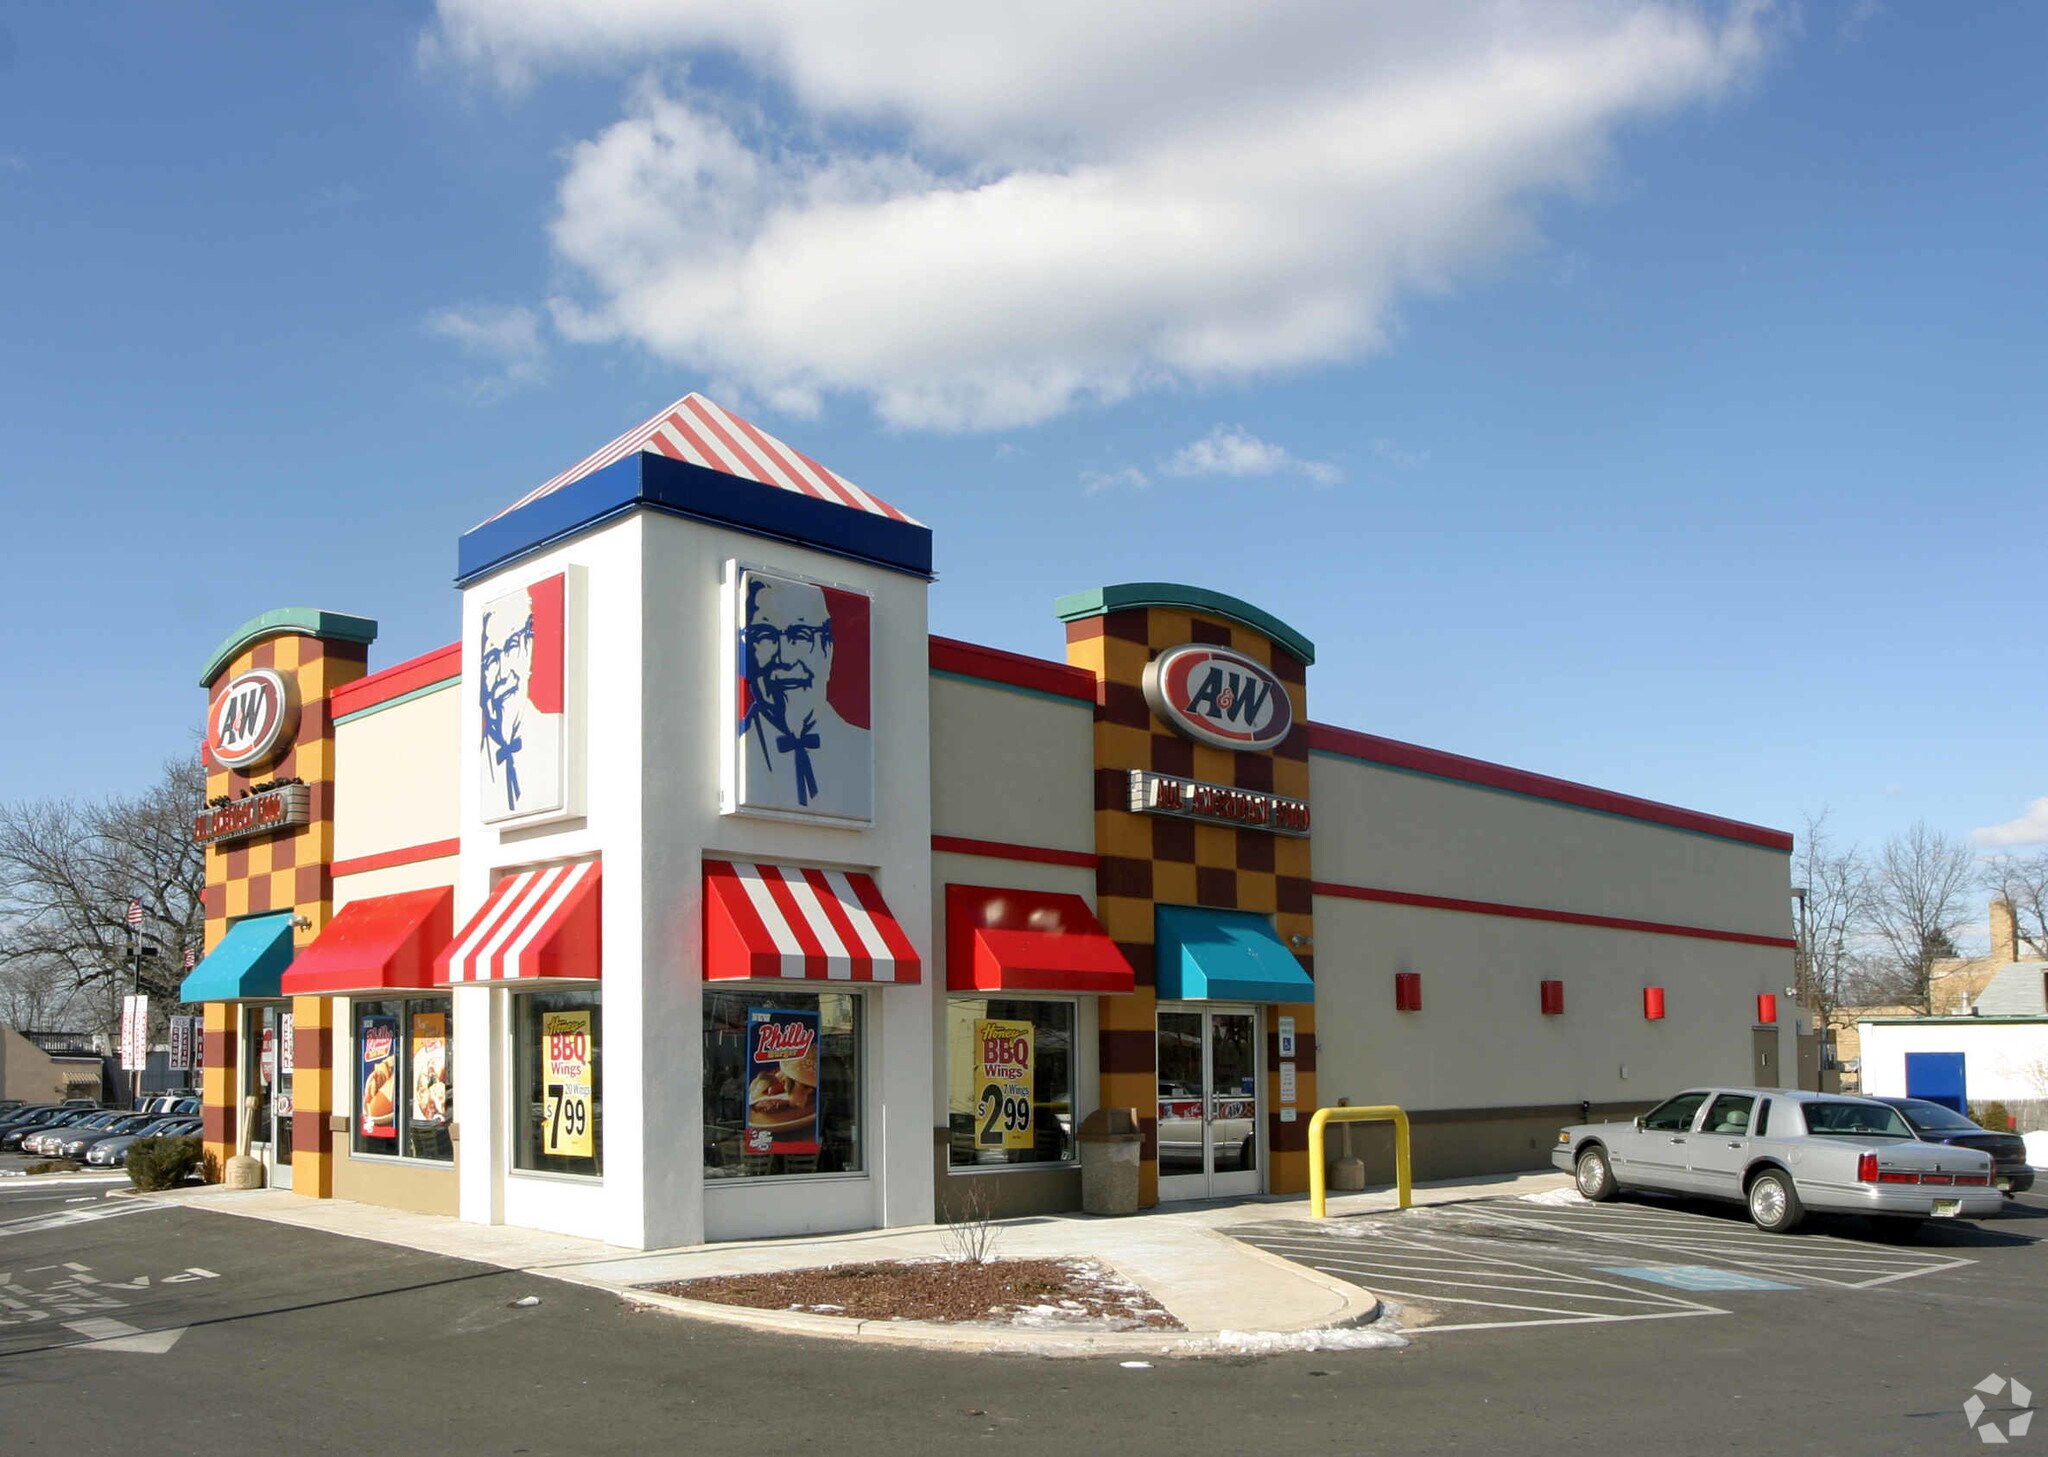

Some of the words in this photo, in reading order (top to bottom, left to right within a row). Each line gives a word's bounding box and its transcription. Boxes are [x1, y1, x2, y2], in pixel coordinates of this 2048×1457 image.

[1184, 666, 1273, 727] A&W
[217, 683, 267, 747] A&W
[758, 1021, 815, 1053] Philly
[981, 1023, 1029, 1040] Honey
[550, 1031, 586, 1066] BBQ
[984, 1038, 1029, 1070] BBQ
[551, 1062, 582, 1078] Wings
[984, 1064, 1023, 1080] Wings
